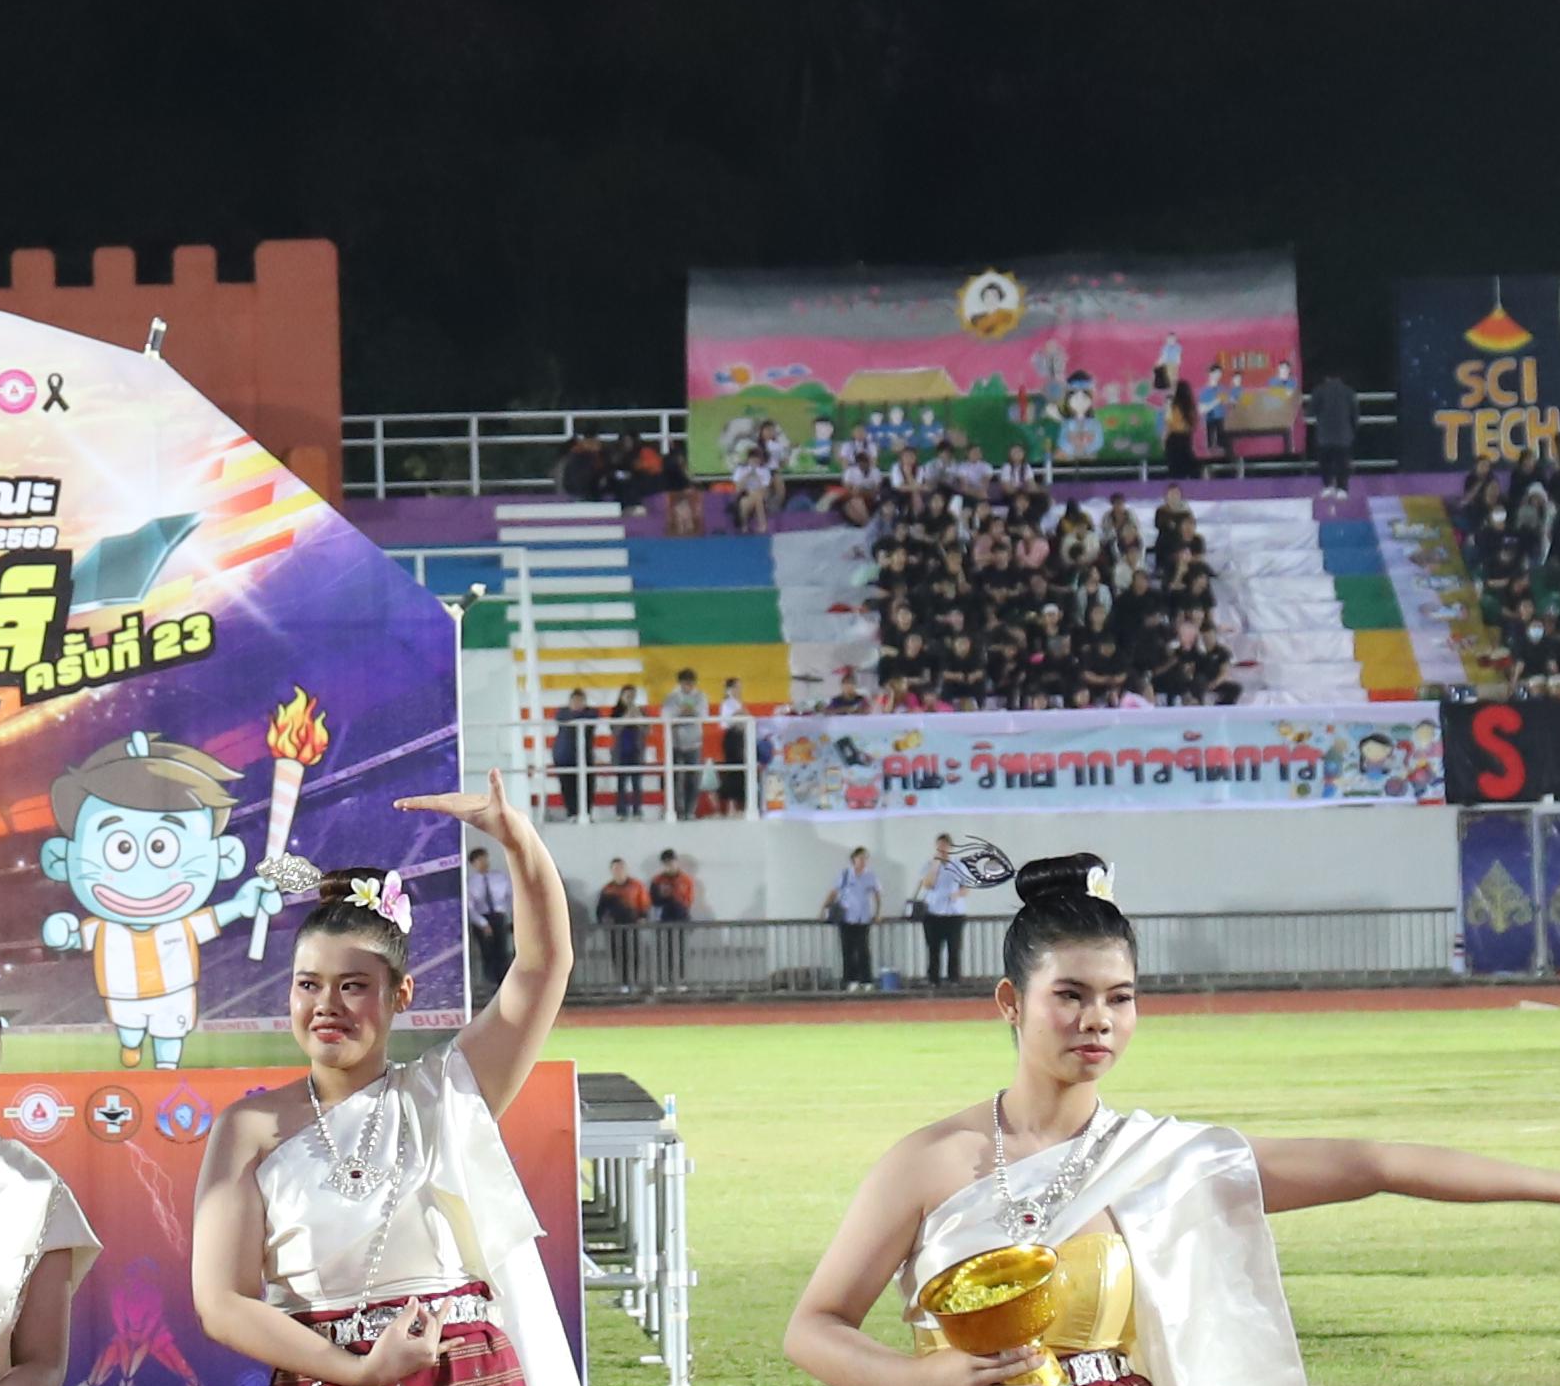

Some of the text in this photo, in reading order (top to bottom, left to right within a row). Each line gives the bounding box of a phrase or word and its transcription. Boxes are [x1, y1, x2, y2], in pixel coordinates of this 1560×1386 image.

[1455, 356, 1538, 408] SCI
[24, 613, 214, 694] ครั้งที่ 23
